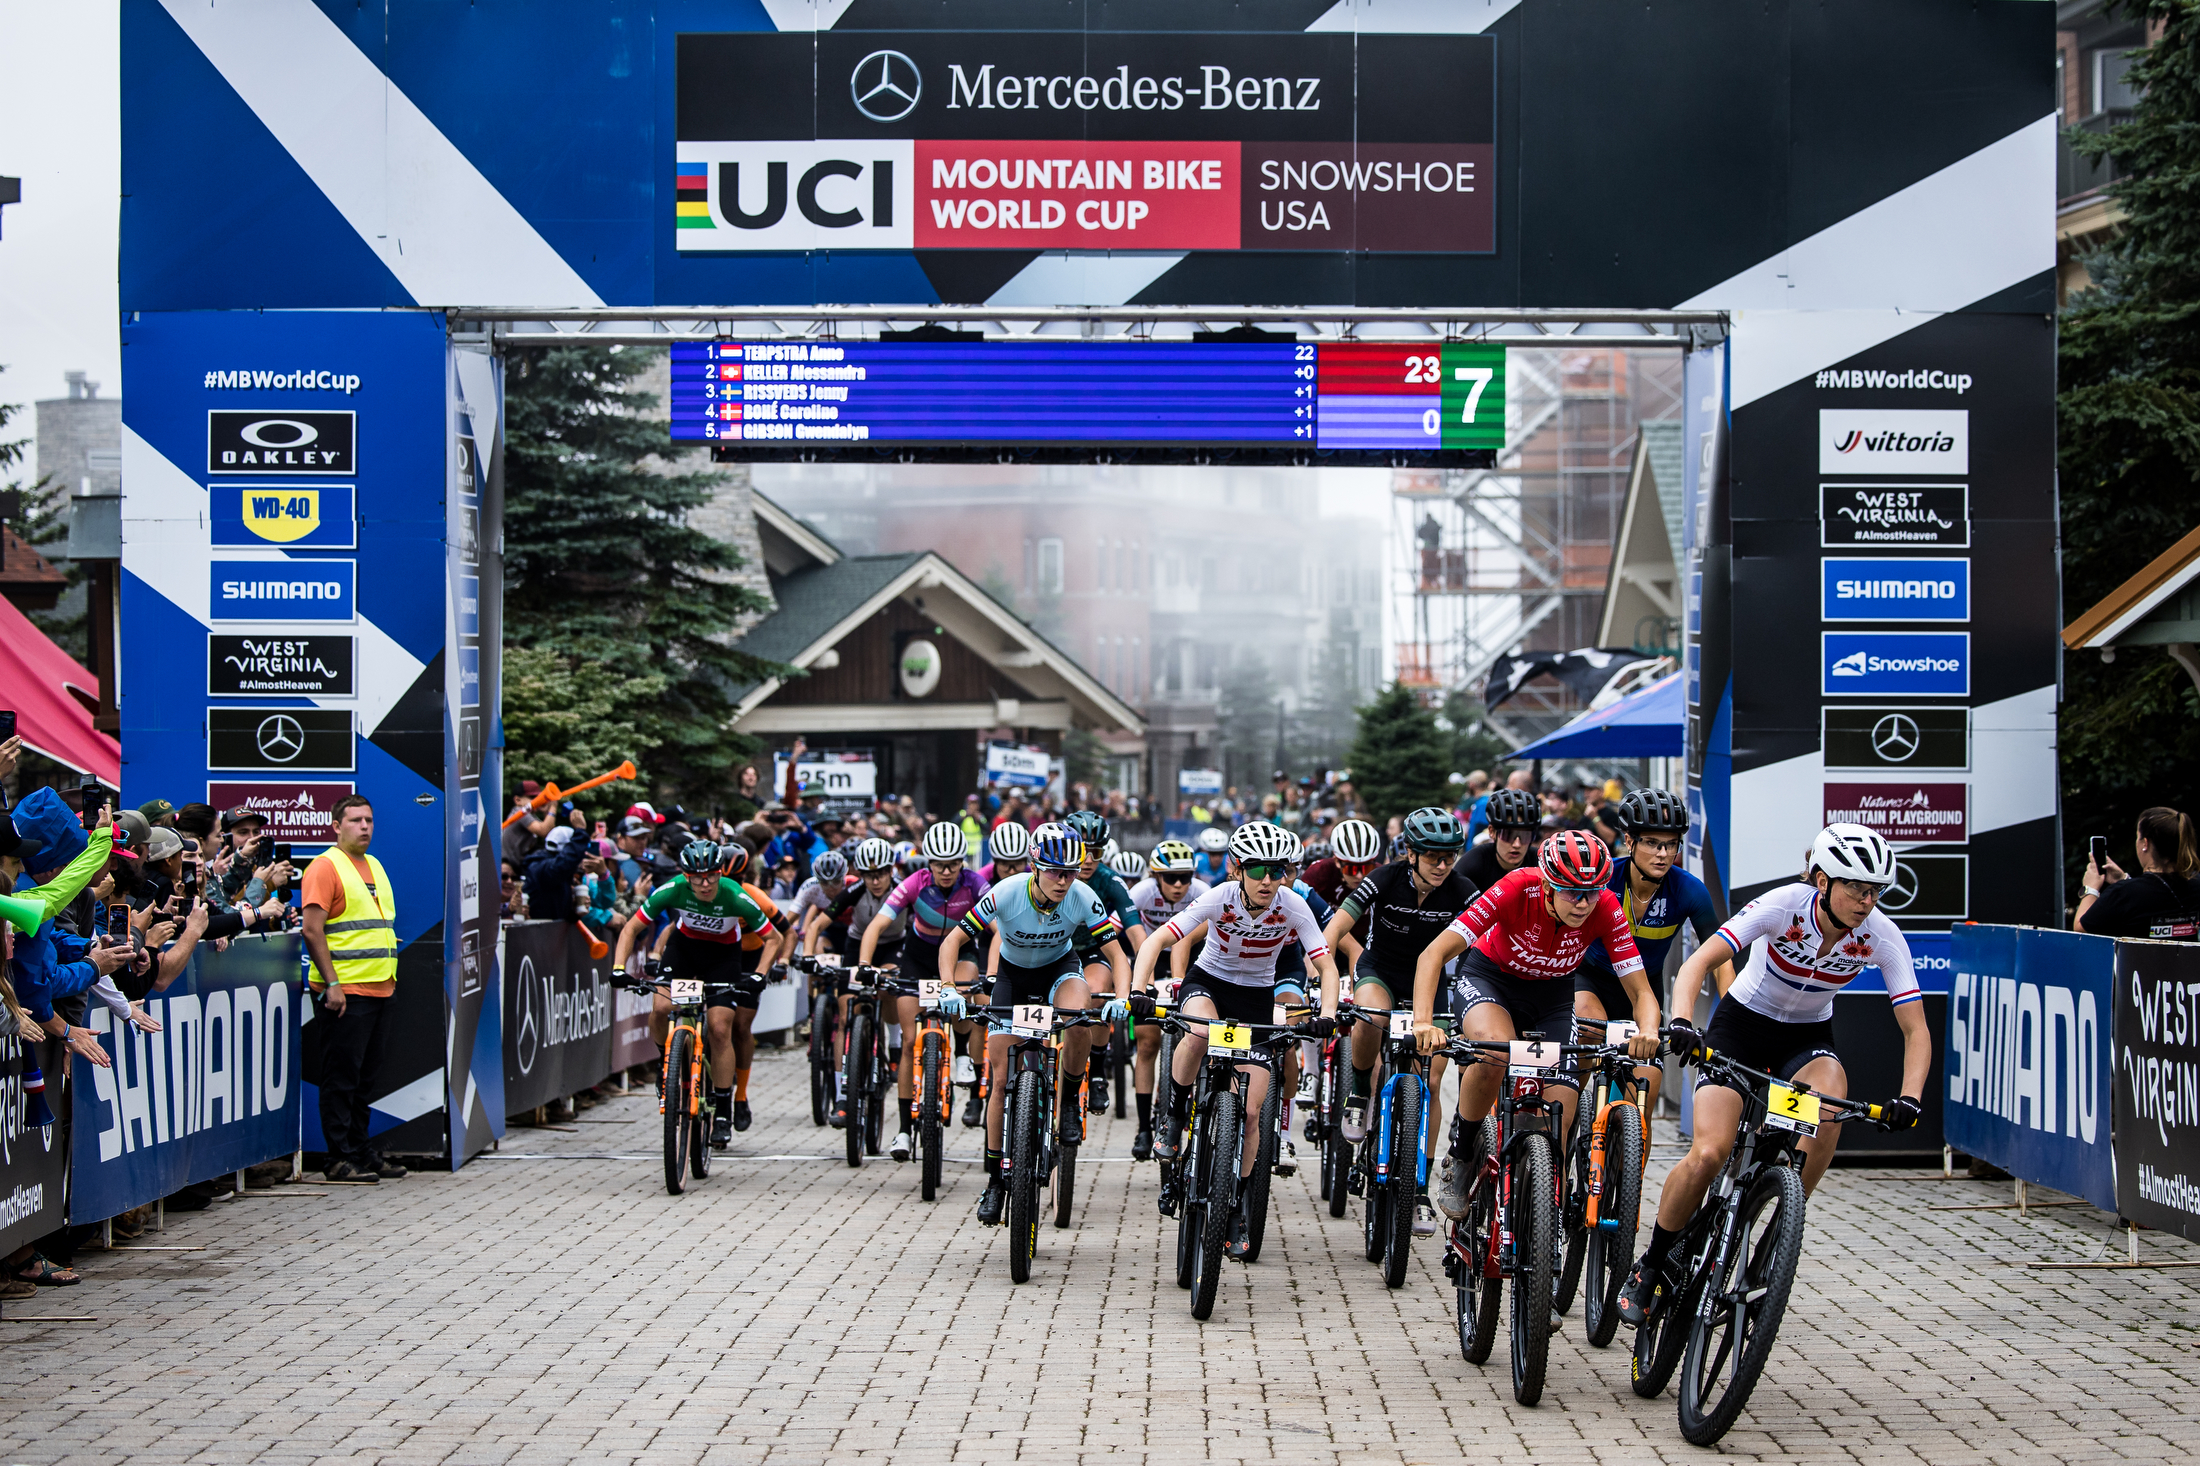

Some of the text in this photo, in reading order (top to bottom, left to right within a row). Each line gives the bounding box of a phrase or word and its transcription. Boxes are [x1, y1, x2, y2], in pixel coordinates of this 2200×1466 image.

[947, 64, 1321, 111] Mercedes-Benz
[932, 158, 1222, 190] MOUNTAIN BIKE
[1260, 160, 1475, 194] SNOWSHOE
[718, 158, 895, 229] UCI
[932, 199, 1149, 231] WORLD CUP
[1260, 201, 1331, 232] USA
[706, 345, 719, 360] 1.
[743, 345, 808, 361] TERPSTRA
[1295, 345, 1314, 360] 22
[705, 364, 1314, 380] 2. KELLER Alessandra +0
[204, 370, 360, 394] #MBWorldCup
[1404, 356, 1493, 423] 23 7
[1815, 369, 1972, 394] #MBWorldCup
[705, 383, 719, 399] 3.
[809, 384, 848, 402] Jenny
[1294, 385, 1312, 399] +1
[705, 403, 719, 418] 4.
[780, 404, 838, 420] Caroline
[1294, 404, 1312, 419] +1
[1422, 409, 1441, 435] 0
[705, 423, 719, 438] 5.
[743, 424, 793, 439] GIBSON
[1294, 424, 1312, 438] +1
[1864, 431, 1954, 452] vittoria
[222, 451, 337, 464] OAKLEY
[252, 497, 311, 519] WD-40
[1856, 491, 1922, 508] WEST
[1838, 507, 1952, 529] VIRGINIA
[1854, 531, 1937, 541] #AlmostHeaven
[222, 581, 341, 599] SHIMANO
[1836, 580, 1955, 599] SHIMANO
[243, 639, 309, 656] WEST
[225, 656, 337, 678] VIRGINIA
[1868, 656, 1959, 672] Snowshoe
[240, 680, 322, 690] #AlmostHeaven
[245, 796, 289, 808] Nature's
[1859, 795, 1904, 808] Nature's
[275, 811, 332, 826] PLAYGROU
[1827, 810, 1962, 825] MOUNTAIN PLAYGROUND
[686, 912, 724, 924] SANTA
[1384, 904, 1453, 917] NORCO
[693, 920, 724, 930] CRUZ
[2154, 927, 2171, 935] UCI
[1014, 930, 1065, 940] SRAM
[677, 982, 698, 992] 24
[543, 968, 610, 1048] Mercedes-Ben
[1022, 1007, 1044, 1024] 14
[2132, 970, 2200, 1047] WEST
[1224, 1032, 1234, 1043] 8
[1527, 1041, 1544, 1058] 4
[1950, 973, 2097, 1145] SHIMANO
[90, 981, 288, 1163] SHIMANO
[1786, 1097, 1800, 1114] 2
